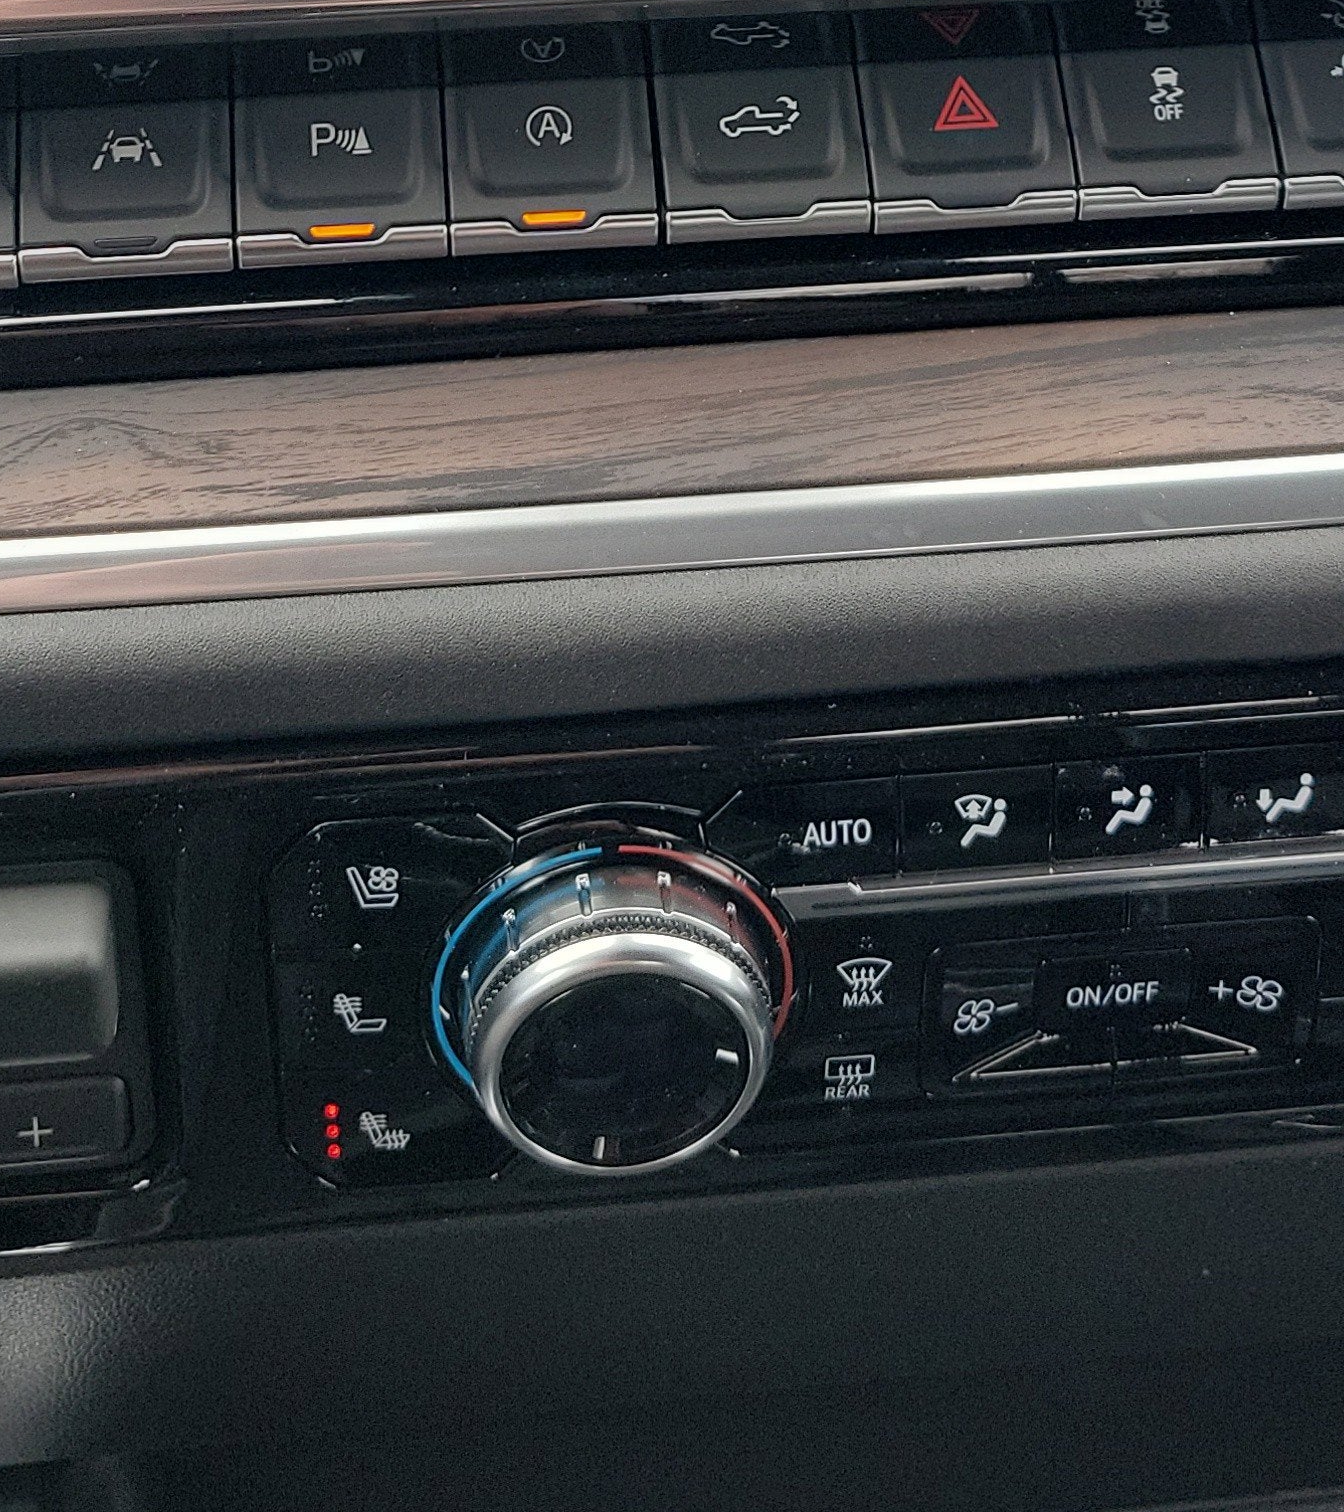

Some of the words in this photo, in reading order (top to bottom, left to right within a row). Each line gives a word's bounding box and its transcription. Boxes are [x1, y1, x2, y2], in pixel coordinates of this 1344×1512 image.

[1154, 100, 1184, 122] OFF
[804, 818, 872, 847] AUTO
[842, 990, 884, 1007] MAX
[1066, 980, 1160, 1009] ON/OFF
[825, 1080, 871, 1100] REAR
